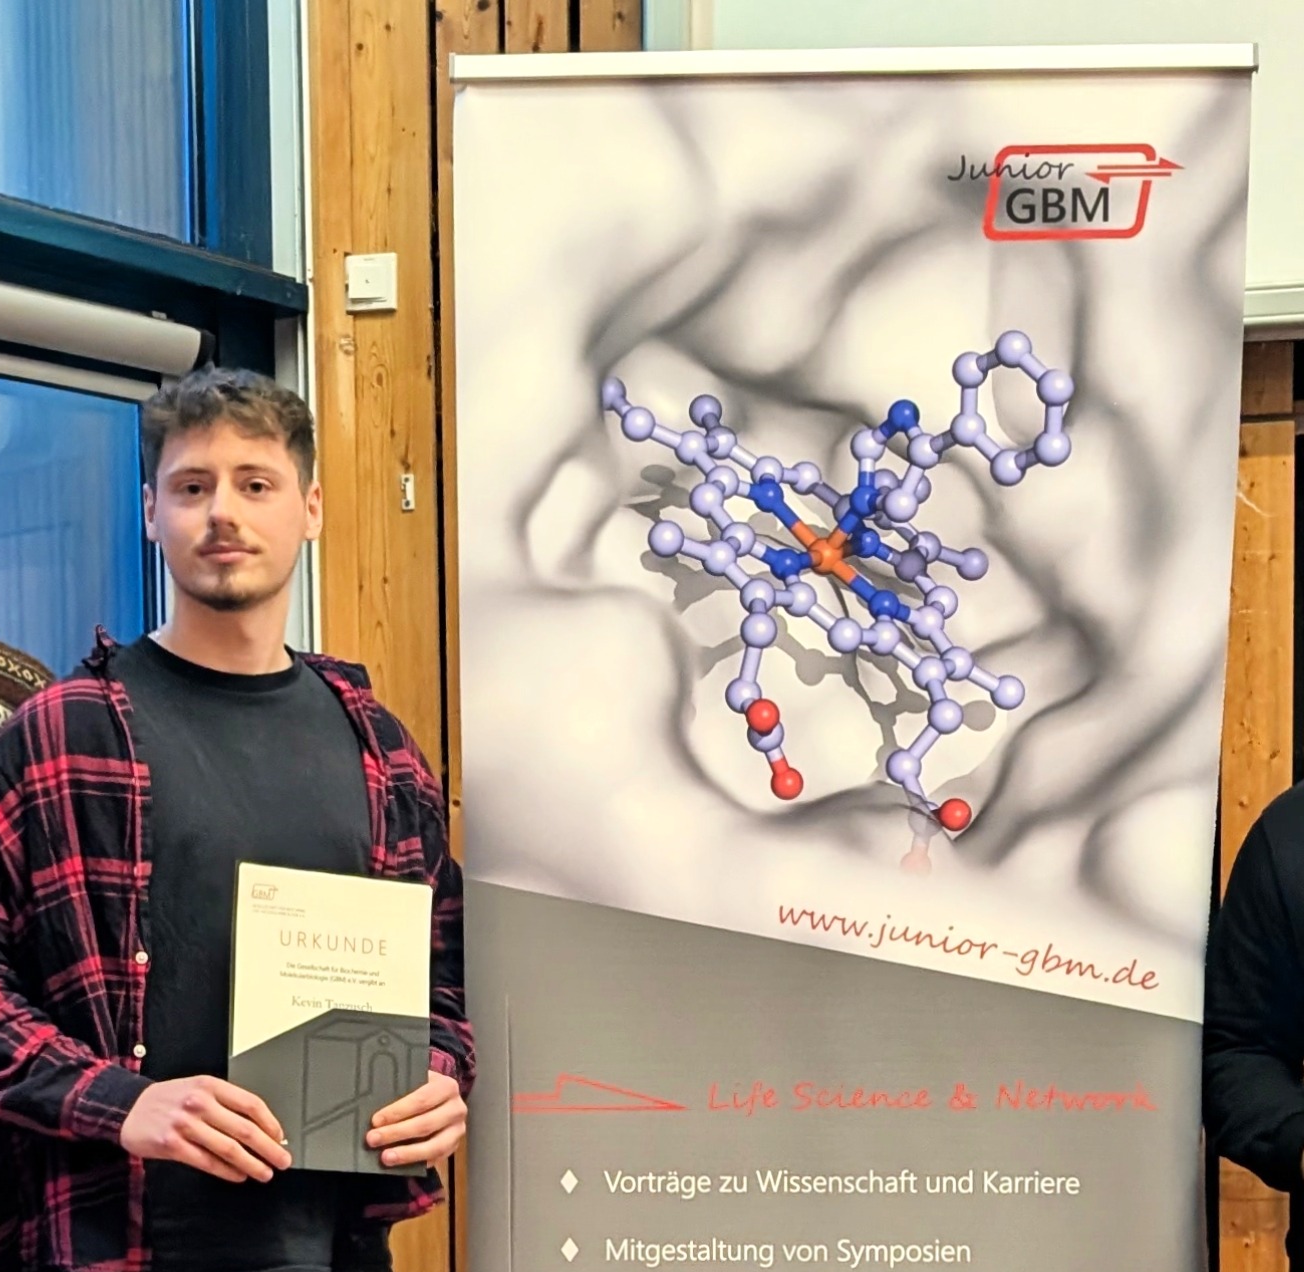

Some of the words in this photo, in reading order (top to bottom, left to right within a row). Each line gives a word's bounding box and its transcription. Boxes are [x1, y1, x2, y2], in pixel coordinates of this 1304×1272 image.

[947, 153, 1075, 181] Junior
[1005, 186, 1110, 225] GBM
[279, 929, 388, 957] URKUNDE
[778, 904, 1160, 991] www.junior-gbm.de
[291, 995, 323, 1009] Kevin
[706, 1080, 780, 1117] Life
[792, 1081, 933, 1113] Science
[946, 1081, 978, 1113] &
[995, 1080, 1158, 1112] Network
[604, 1170, 713, 1199] Vorträge
[720, 1176, 747, 1195] zu
[756, 1170, 917, 1195] Wissenschaft
[927, 1170, 973, 1194] und
[984, 1171, 1080, 1195] Karriere
[606, 1238, 774, 1267] Mitgestaltung
[783, 1245, 827, 1262] von
[838, 1239, 971, 1268] Symposien
